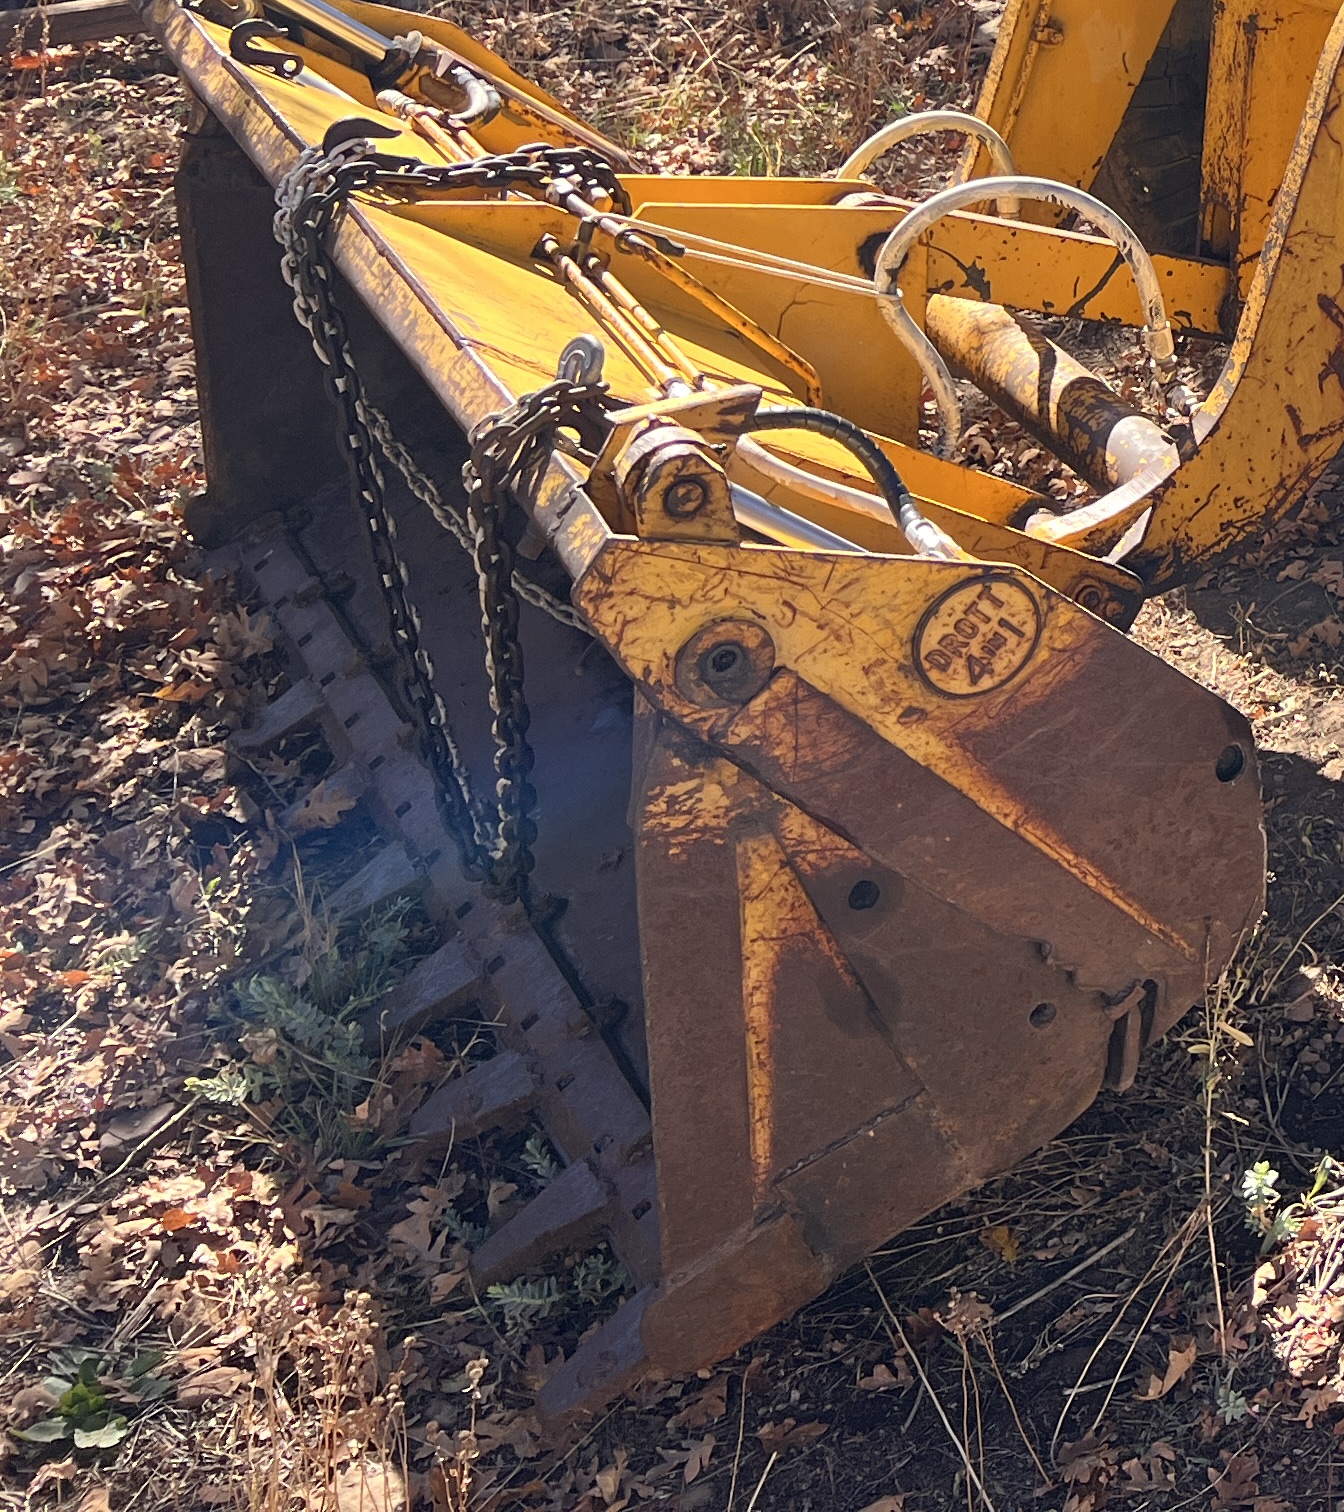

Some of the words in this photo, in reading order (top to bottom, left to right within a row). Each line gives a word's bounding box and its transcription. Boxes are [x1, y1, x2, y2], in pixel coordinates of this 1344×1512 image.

[924, 584, 1005, 673] DROTT
[998, 617, 1026, 639] 1
[980, 631, 1007, 658] IN
[966, 654, 995, 686] 4
